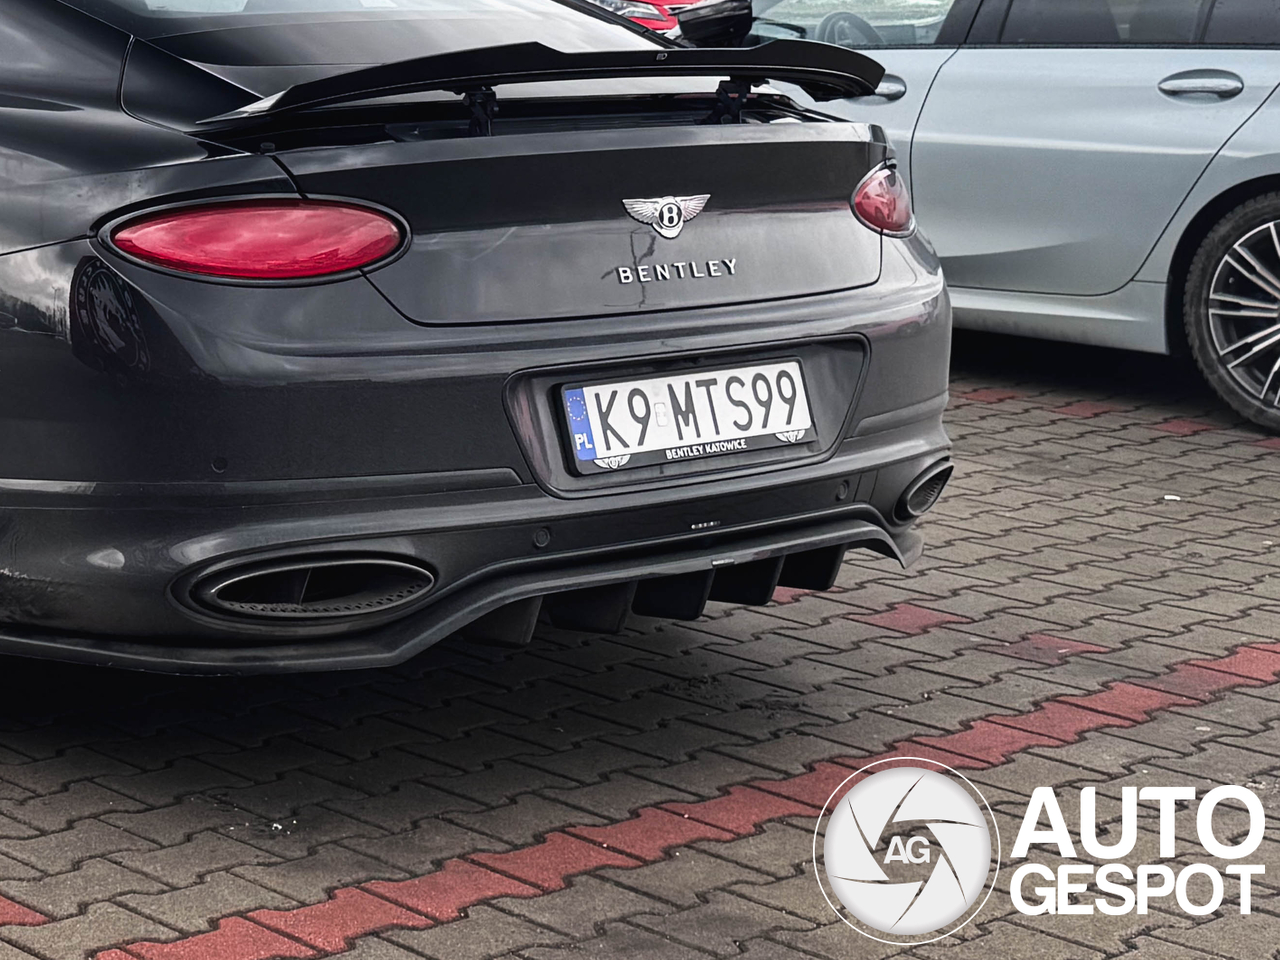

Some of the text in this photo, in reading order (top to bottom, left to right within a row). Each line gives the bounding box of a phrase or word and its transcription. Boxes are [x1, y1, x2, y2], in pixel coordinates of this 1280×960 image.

[618, 258, 736, 283] BENTLEY
[594, 369, 797, 451] K9 MTS99
[575, 433, 593, 450] PL
[665, 439, 748, 460] BENTLEY KATOWICE
